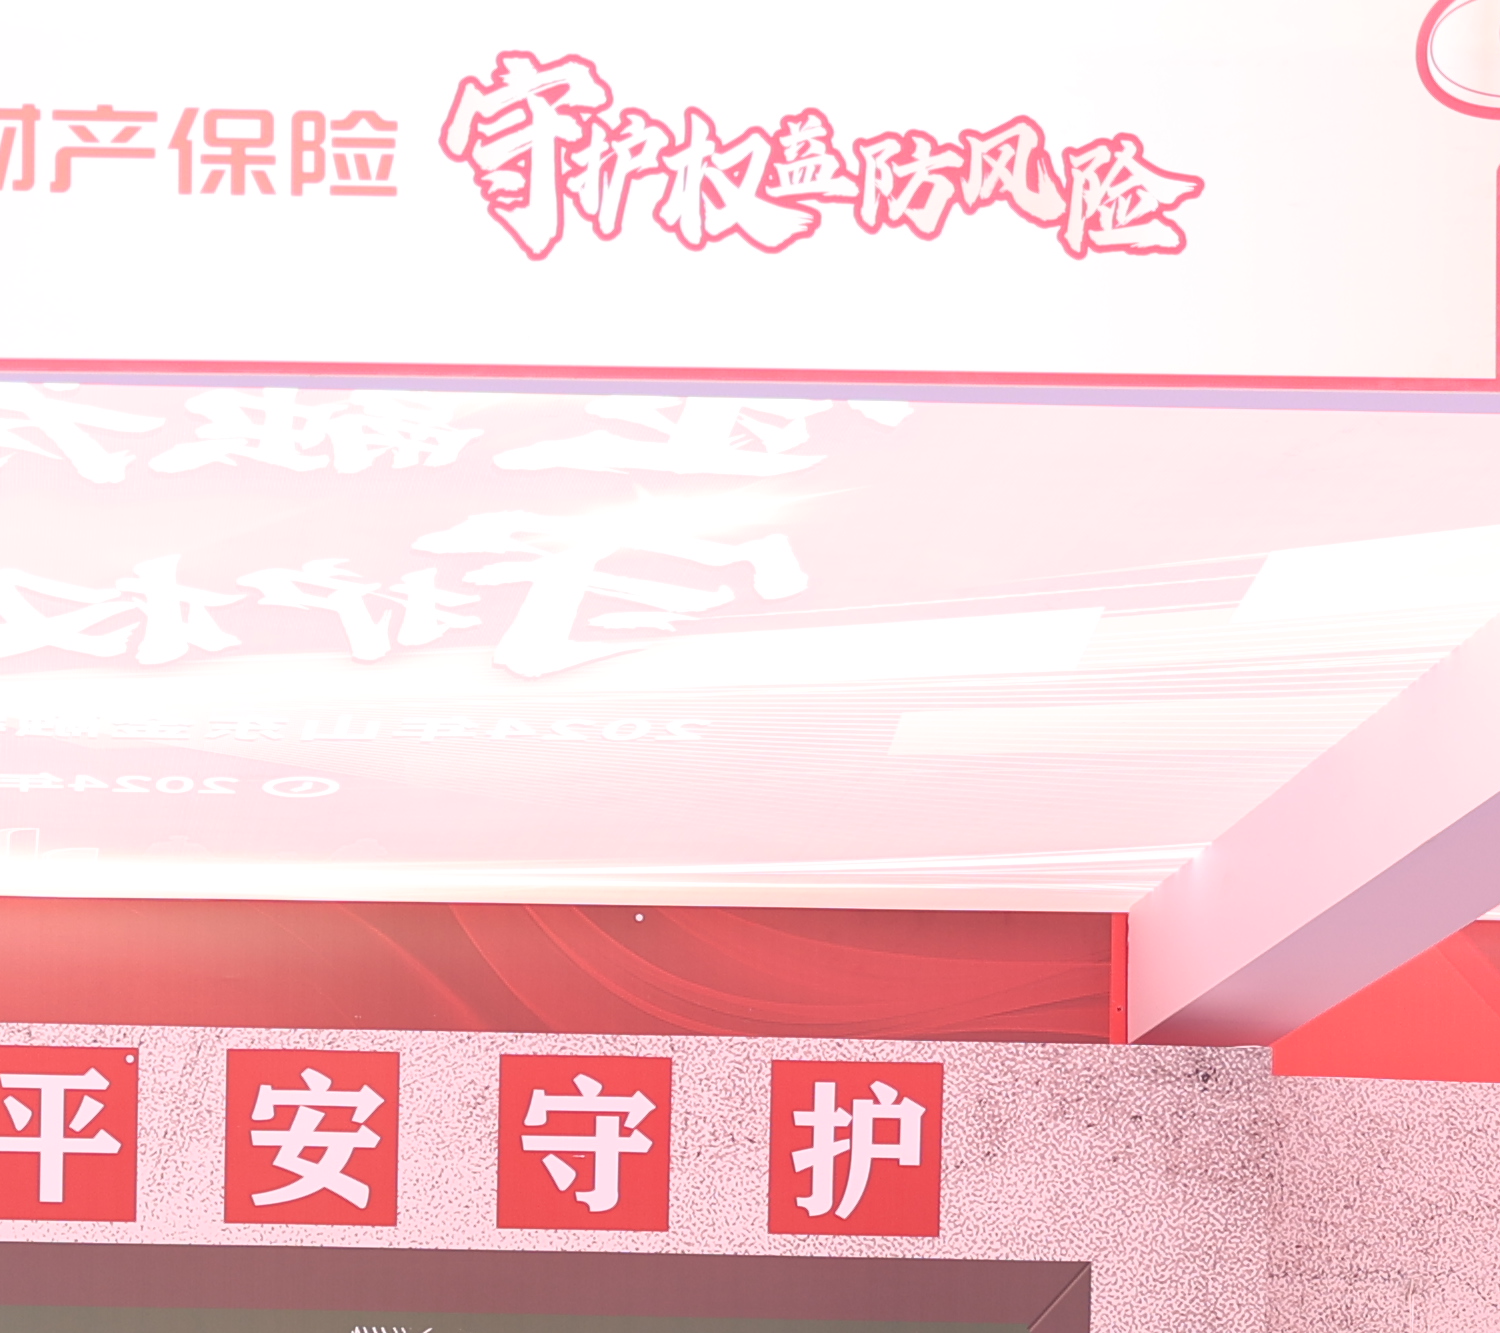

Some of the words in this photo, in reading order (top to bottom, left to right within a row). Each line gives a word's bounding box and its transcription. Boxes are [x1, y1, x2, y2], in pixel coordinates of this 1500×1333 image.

[444, 50, 1206, 258] 守护权益防风险
